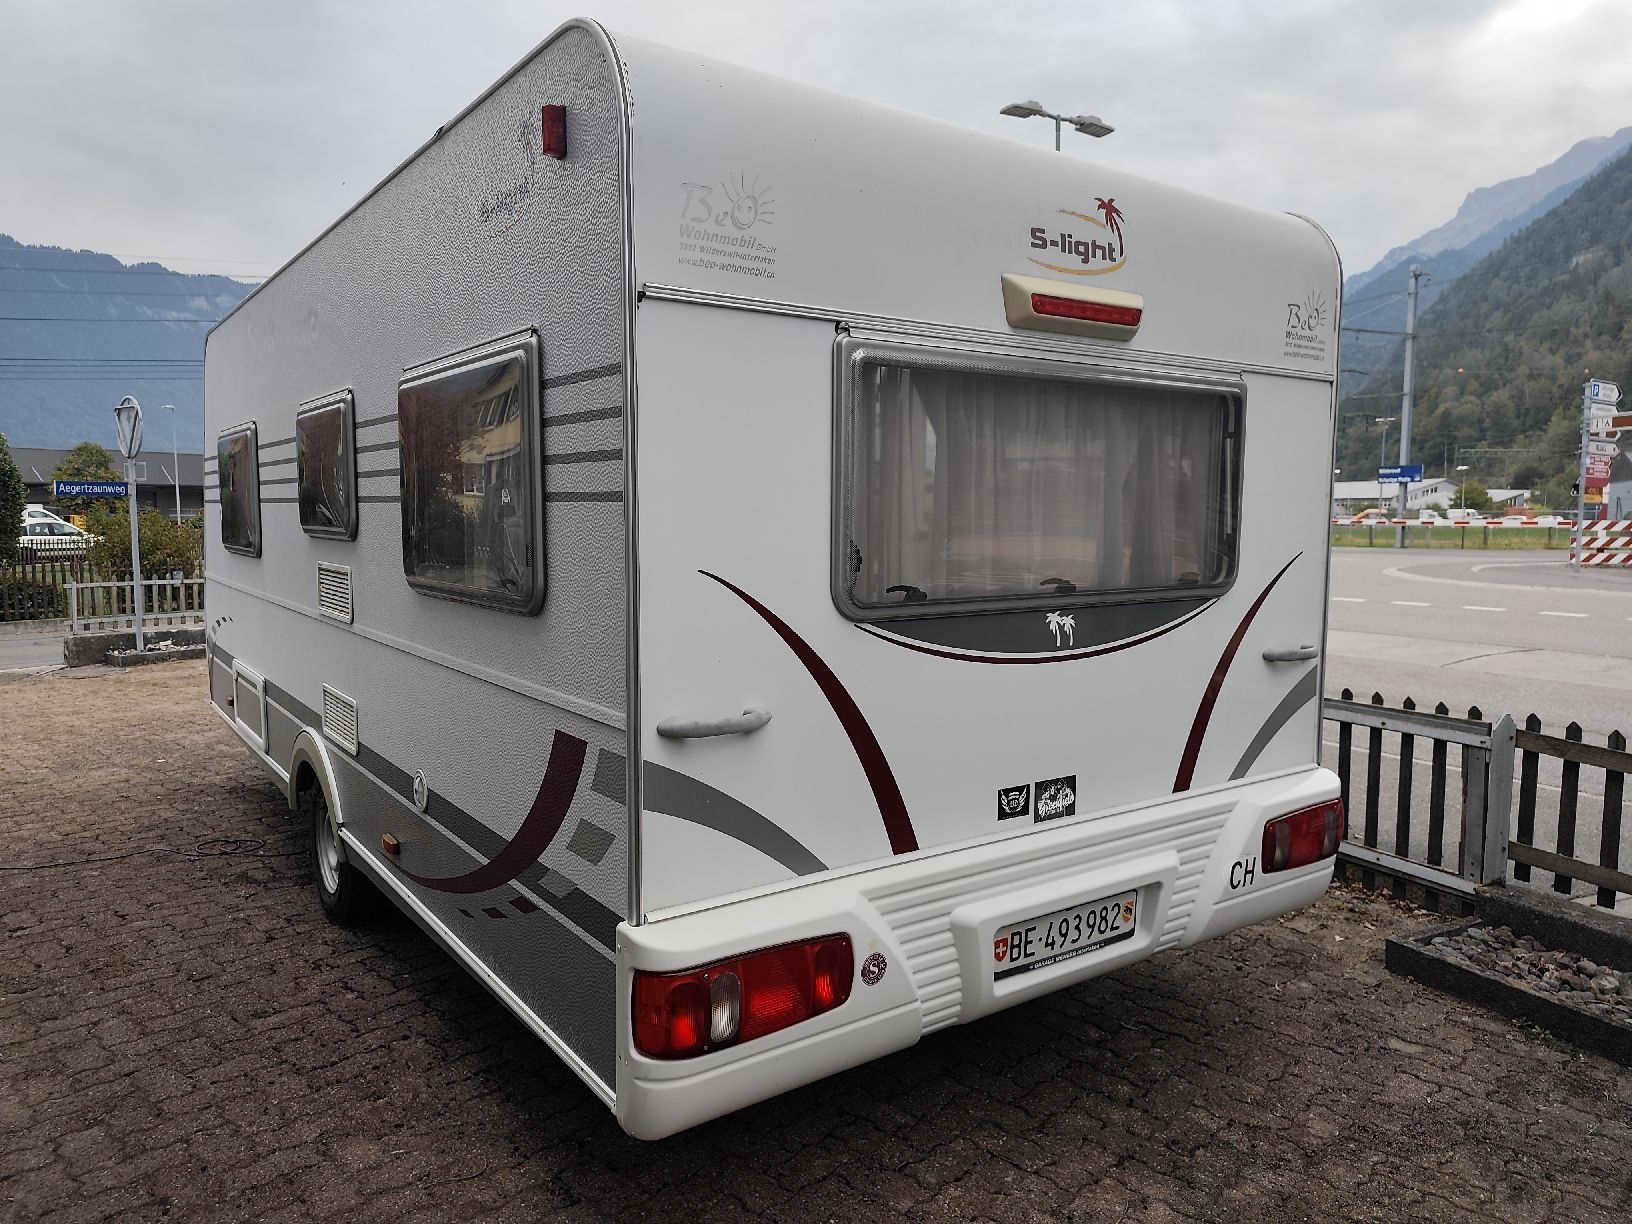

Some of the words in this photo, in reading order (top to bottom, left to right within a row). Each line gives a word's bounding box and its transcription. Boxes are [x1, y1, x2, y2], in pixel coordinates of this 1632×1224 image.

[679, 223, 757, 249] Wohnmobil
[1030, 227, 1117, 264] S-light
[58, 482, 126, 497] Aegertzaunweg
[1230, 856, 1257, 890] CH
